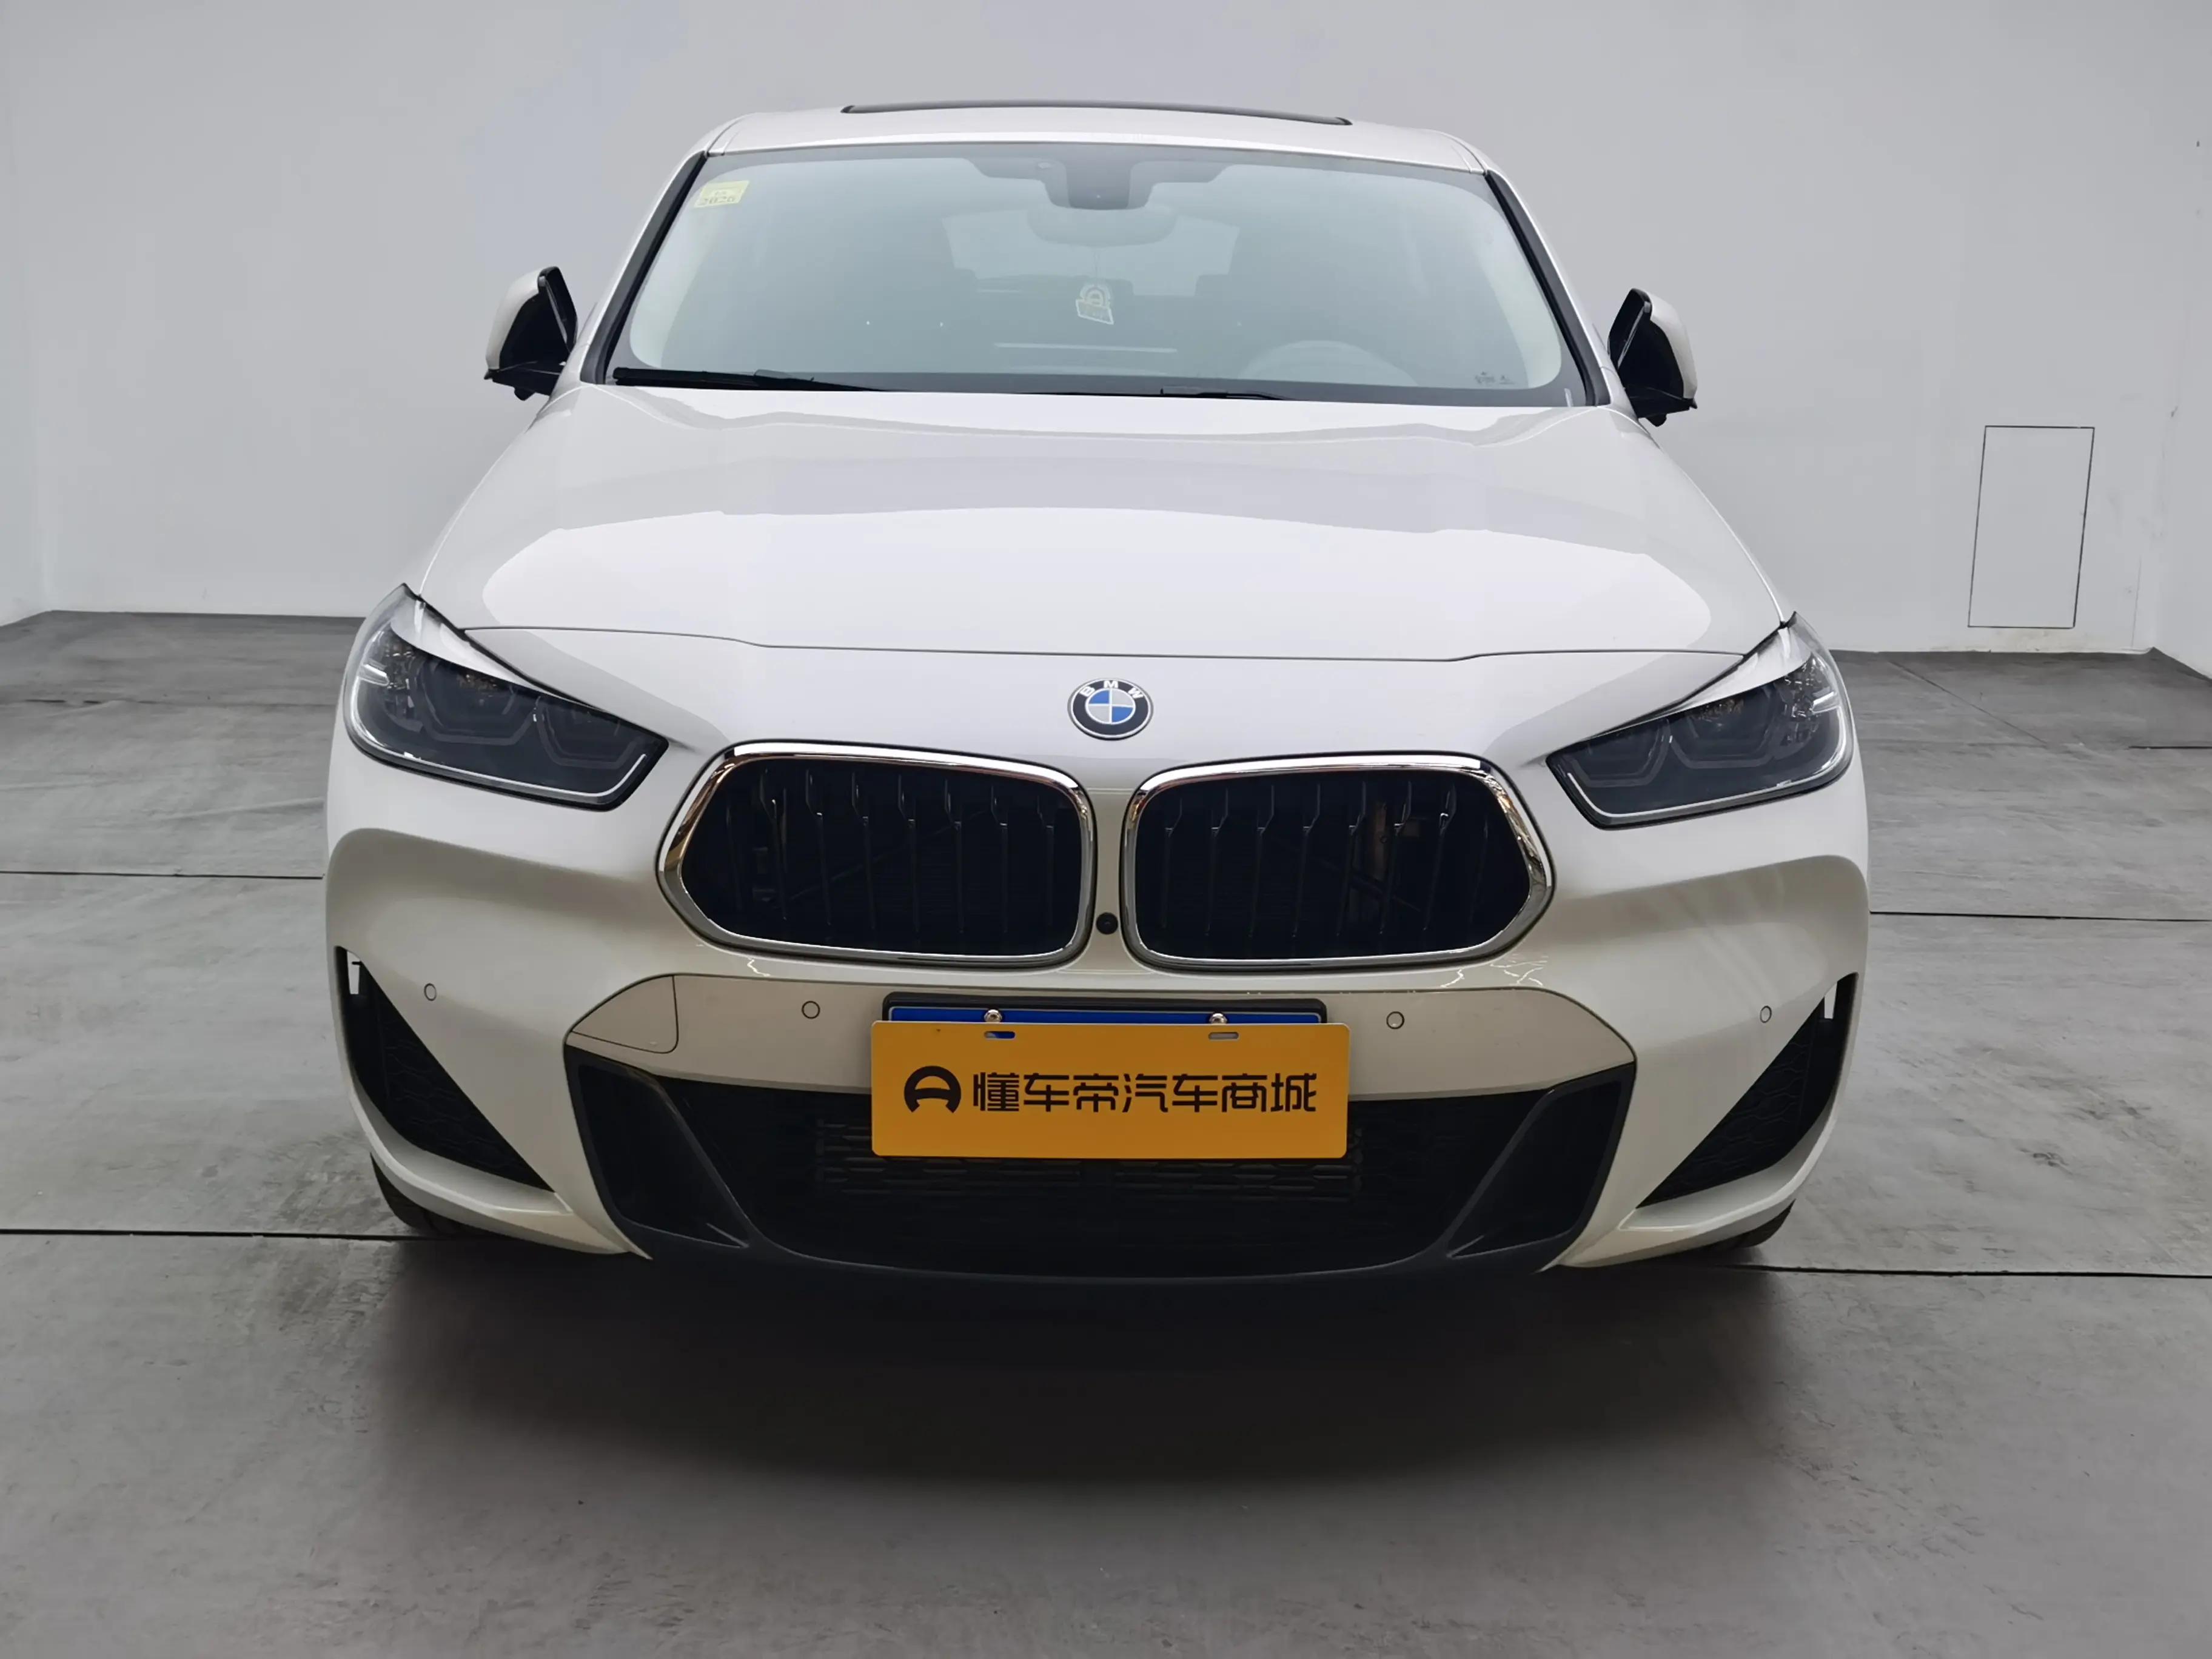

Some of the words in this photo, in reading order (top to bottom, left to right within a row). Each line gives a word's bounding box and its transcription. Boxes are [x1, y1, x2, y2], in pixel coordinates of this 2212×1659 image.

[1079, 680, 1144, 699] BMW
[973, 1072, 1317, 1113] 懂车帝汽车商城
